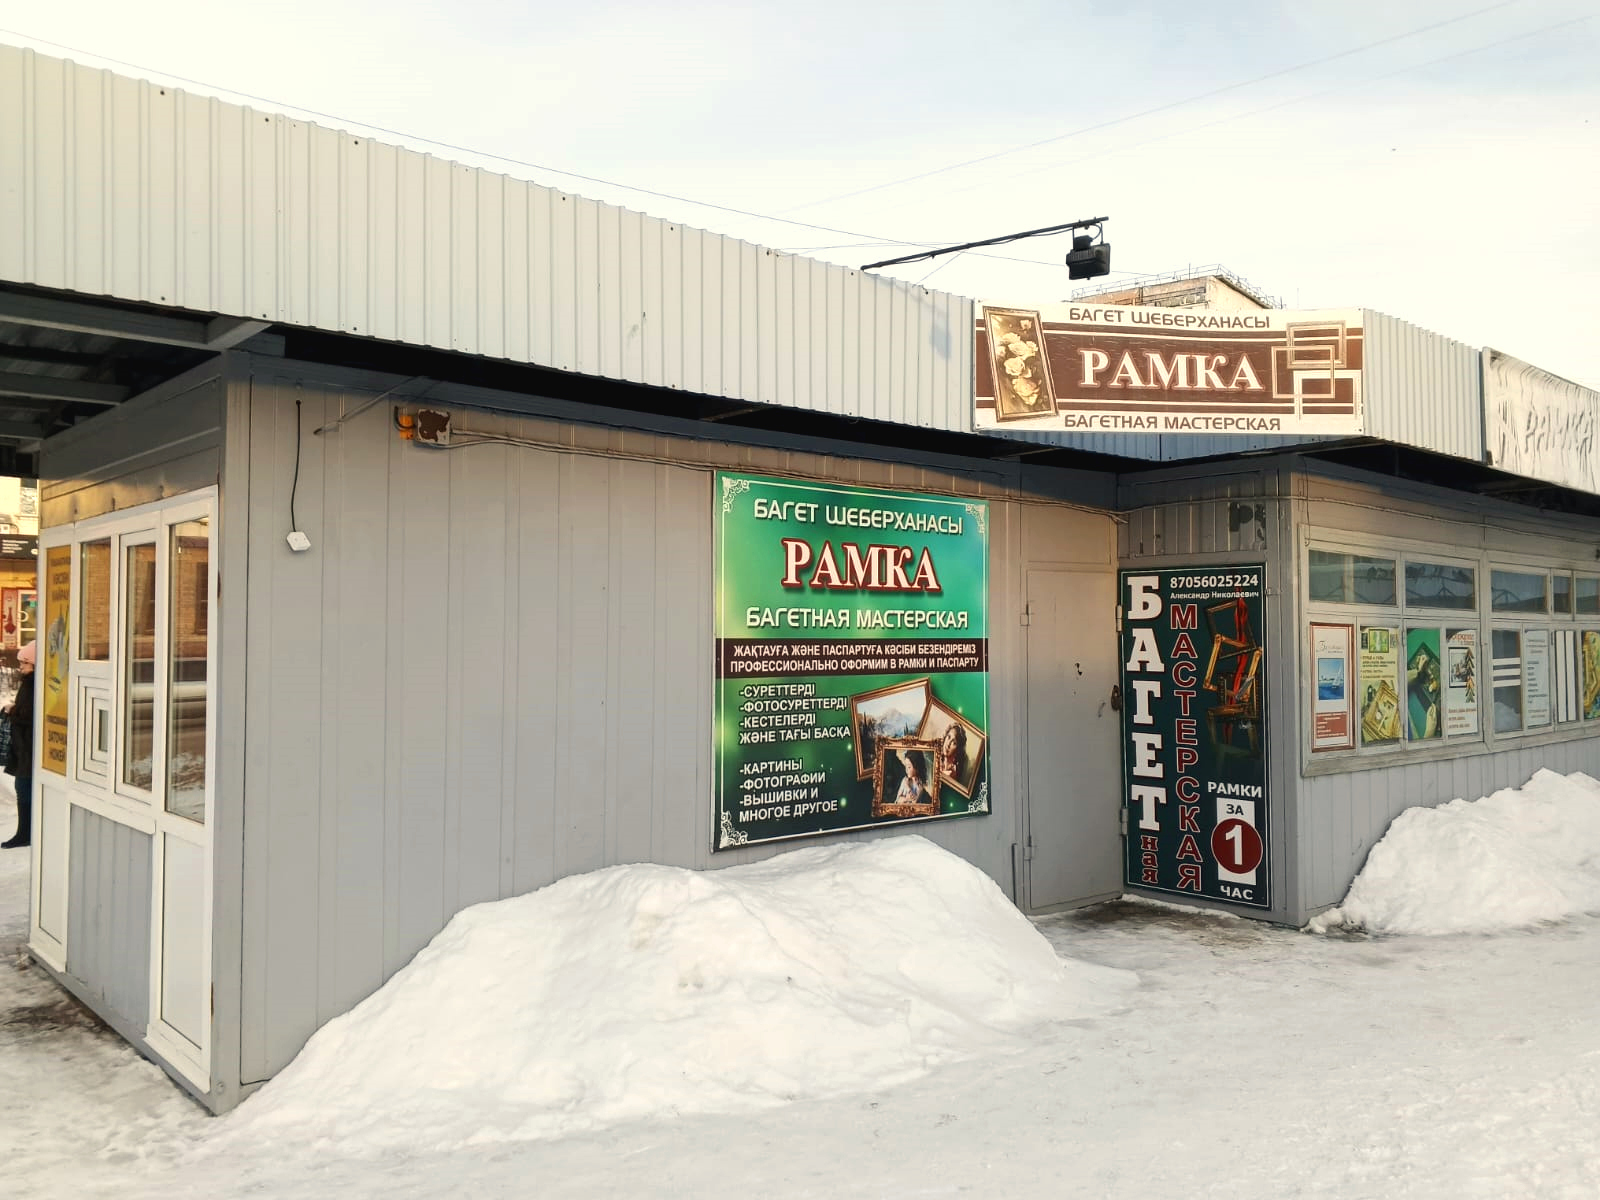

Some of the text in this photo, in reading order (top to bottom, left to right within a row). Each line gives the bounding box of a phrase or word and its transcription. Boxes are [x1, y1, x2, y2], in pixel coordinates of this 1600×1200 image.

[1069, 308, 1270, 329] БАГЕТ ШЕБЕРХАНАСЫ
[1078, 348, 1265, 391] РАМКА
[1064, 414, 1280, 431] БАГЕТНАЯ МАСТЕРСКАЯ
[754, 499, 963, 535] БАГЕТ ШЕБЕРХАНАСЫ
[781, 538, 941, 591] РАМКА
[1170, 575, 1259, 588] 87056025224
[1170, 591, 1259, 600] Александр Николаевич
[746, 607, 968, 629] БАГЕТНАЯ МАСТЕРСКАЯ
[734, 645, 789, 658] ЖАҚТАУҒА
[791, 645, 820, 656] ЖӘНЕ
[822, 644, 883, 656] ПАСПАРТУҒА
[885, 644, 916, 655] КӘСІБИ
[730, 657, 979, 673] ПРОФЕССИОНАЛЬНО ОФОРМИМ В РАМКИ И ПАСПАРТУ
[740, 684, 815, 697] -СУРЕТТЕРДІ
[740, 697, 847, 712] -ФОТОСУРЕТТЕРДІ
[740, 726, 851, 744] ЖӘНЕ ТАҒЫ БАСҚА
[1170, 604, 1204, 891] МАСТЕРСКАЯ
[740, 759, 803, 775] -КАРТИНЫ
[740, 772, 826, 790] -ФОТОГРАФИИ
[1207, 781, 1262, 798] РАМКИ
[740, 787, 819, 806] -ВЫШИВКИ И
[740, 800, 838, 822] МНОГОЕ ДРУГОЕ
[1226, 804, 1244, 815] ЗА
[1225, 824, 1243, 865] 1
[1220, 885, 1253, 900] ЧАС
